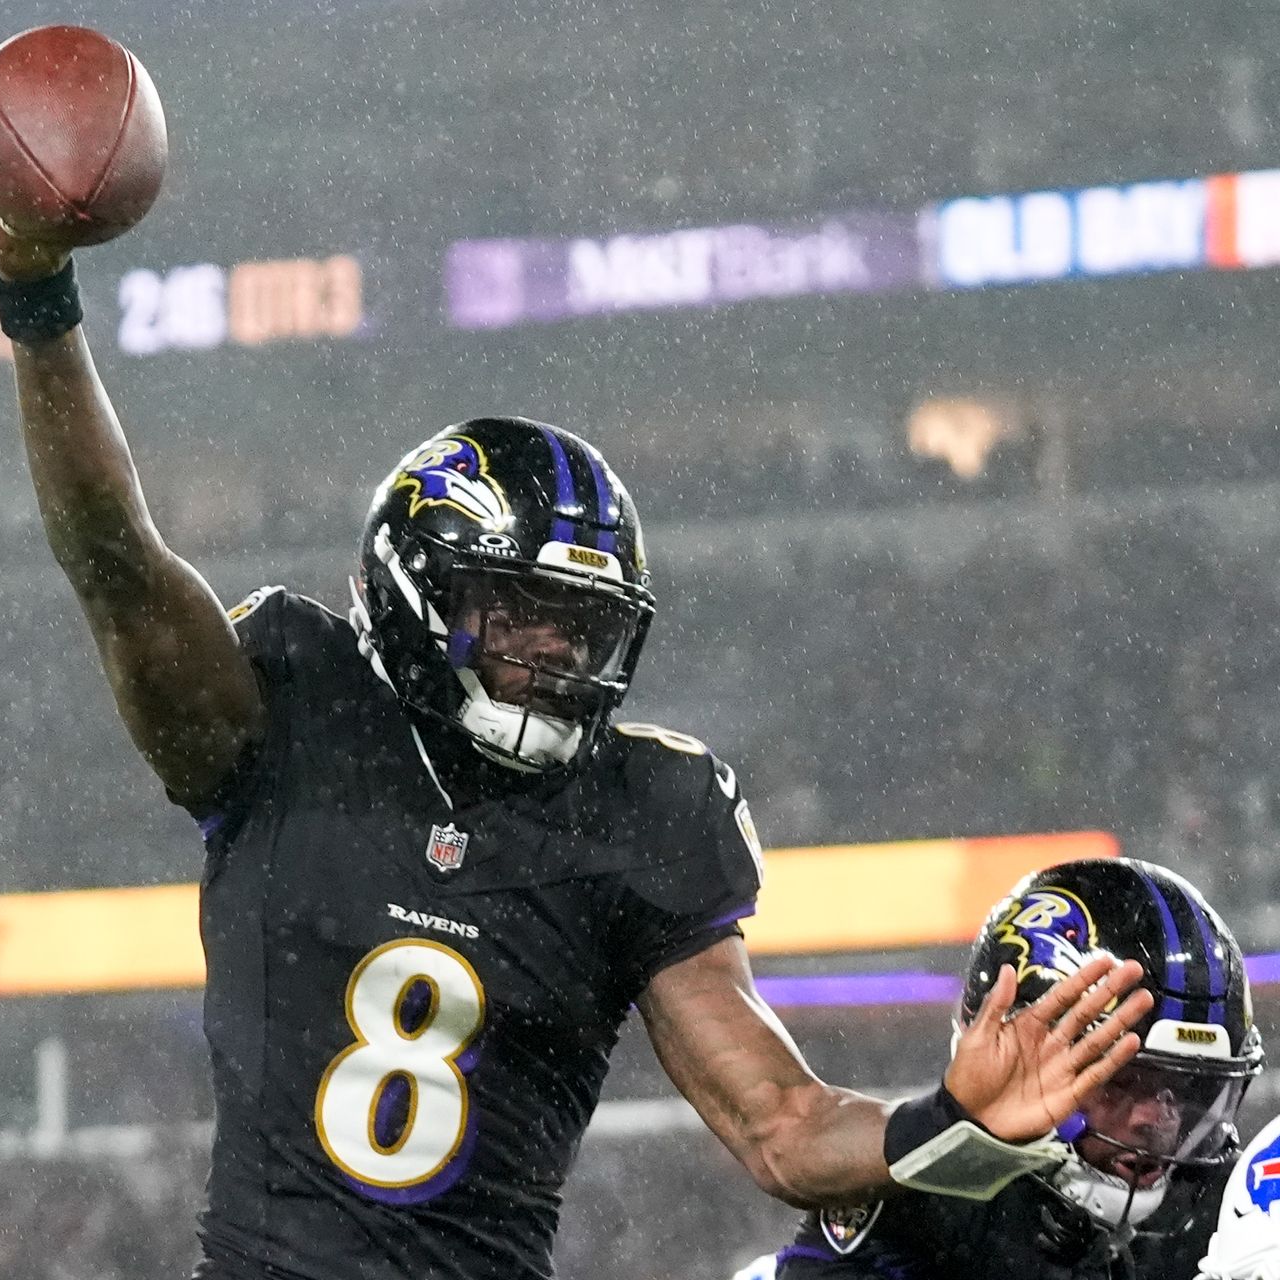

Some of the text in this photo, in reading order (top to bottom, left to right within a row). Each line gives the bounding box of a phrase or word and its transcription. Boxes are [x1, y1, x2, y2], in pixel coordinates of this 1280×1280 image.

[568, 547, 608, 569] RAVENS
[387, 903, 480, 939] RAVENS
[1176, 1027, 1217, 1045] RAVENS
[315, 938, 487, 1200] 8
